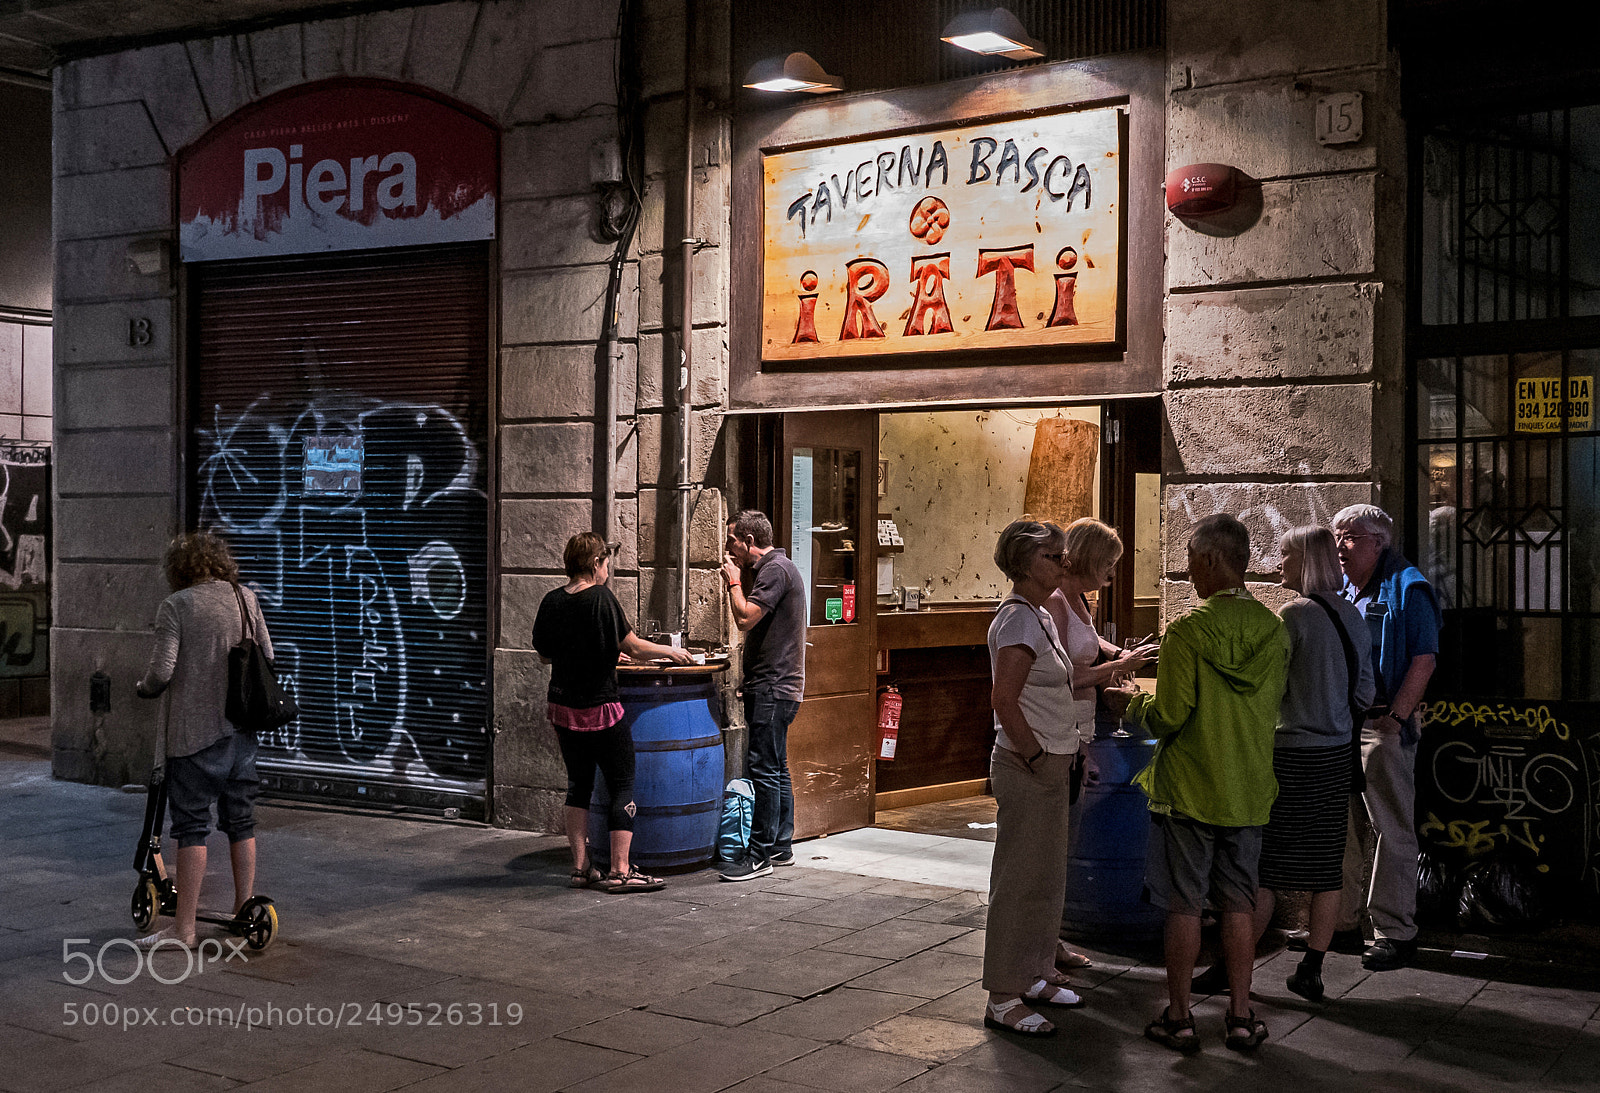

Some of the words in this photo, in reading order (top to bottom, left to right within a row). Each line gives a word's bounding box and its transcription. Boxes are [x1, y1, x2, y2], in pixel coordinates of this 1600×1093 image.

[1325, 101, 1354, 134] 15
[243, 129, 266, 140] CASA
[270, 126, 298, 137] PIERA
[243, 144, 417, 218] Piera
[786, 140, 949, 239] TAVERNA
[965, 136, 1093, 213] BASCA
[126, 316, 153, 347] 13
[1518, 381, 1536, 400] EN
[1541, 379, 1589, 399] VEDA
[1518, 402, 1540, 419] 934
[1543, 402, 1563, 418] 120
[1566, 400, 1589, 418] 990
[1518, 421, 1544, 431] FINQUES
